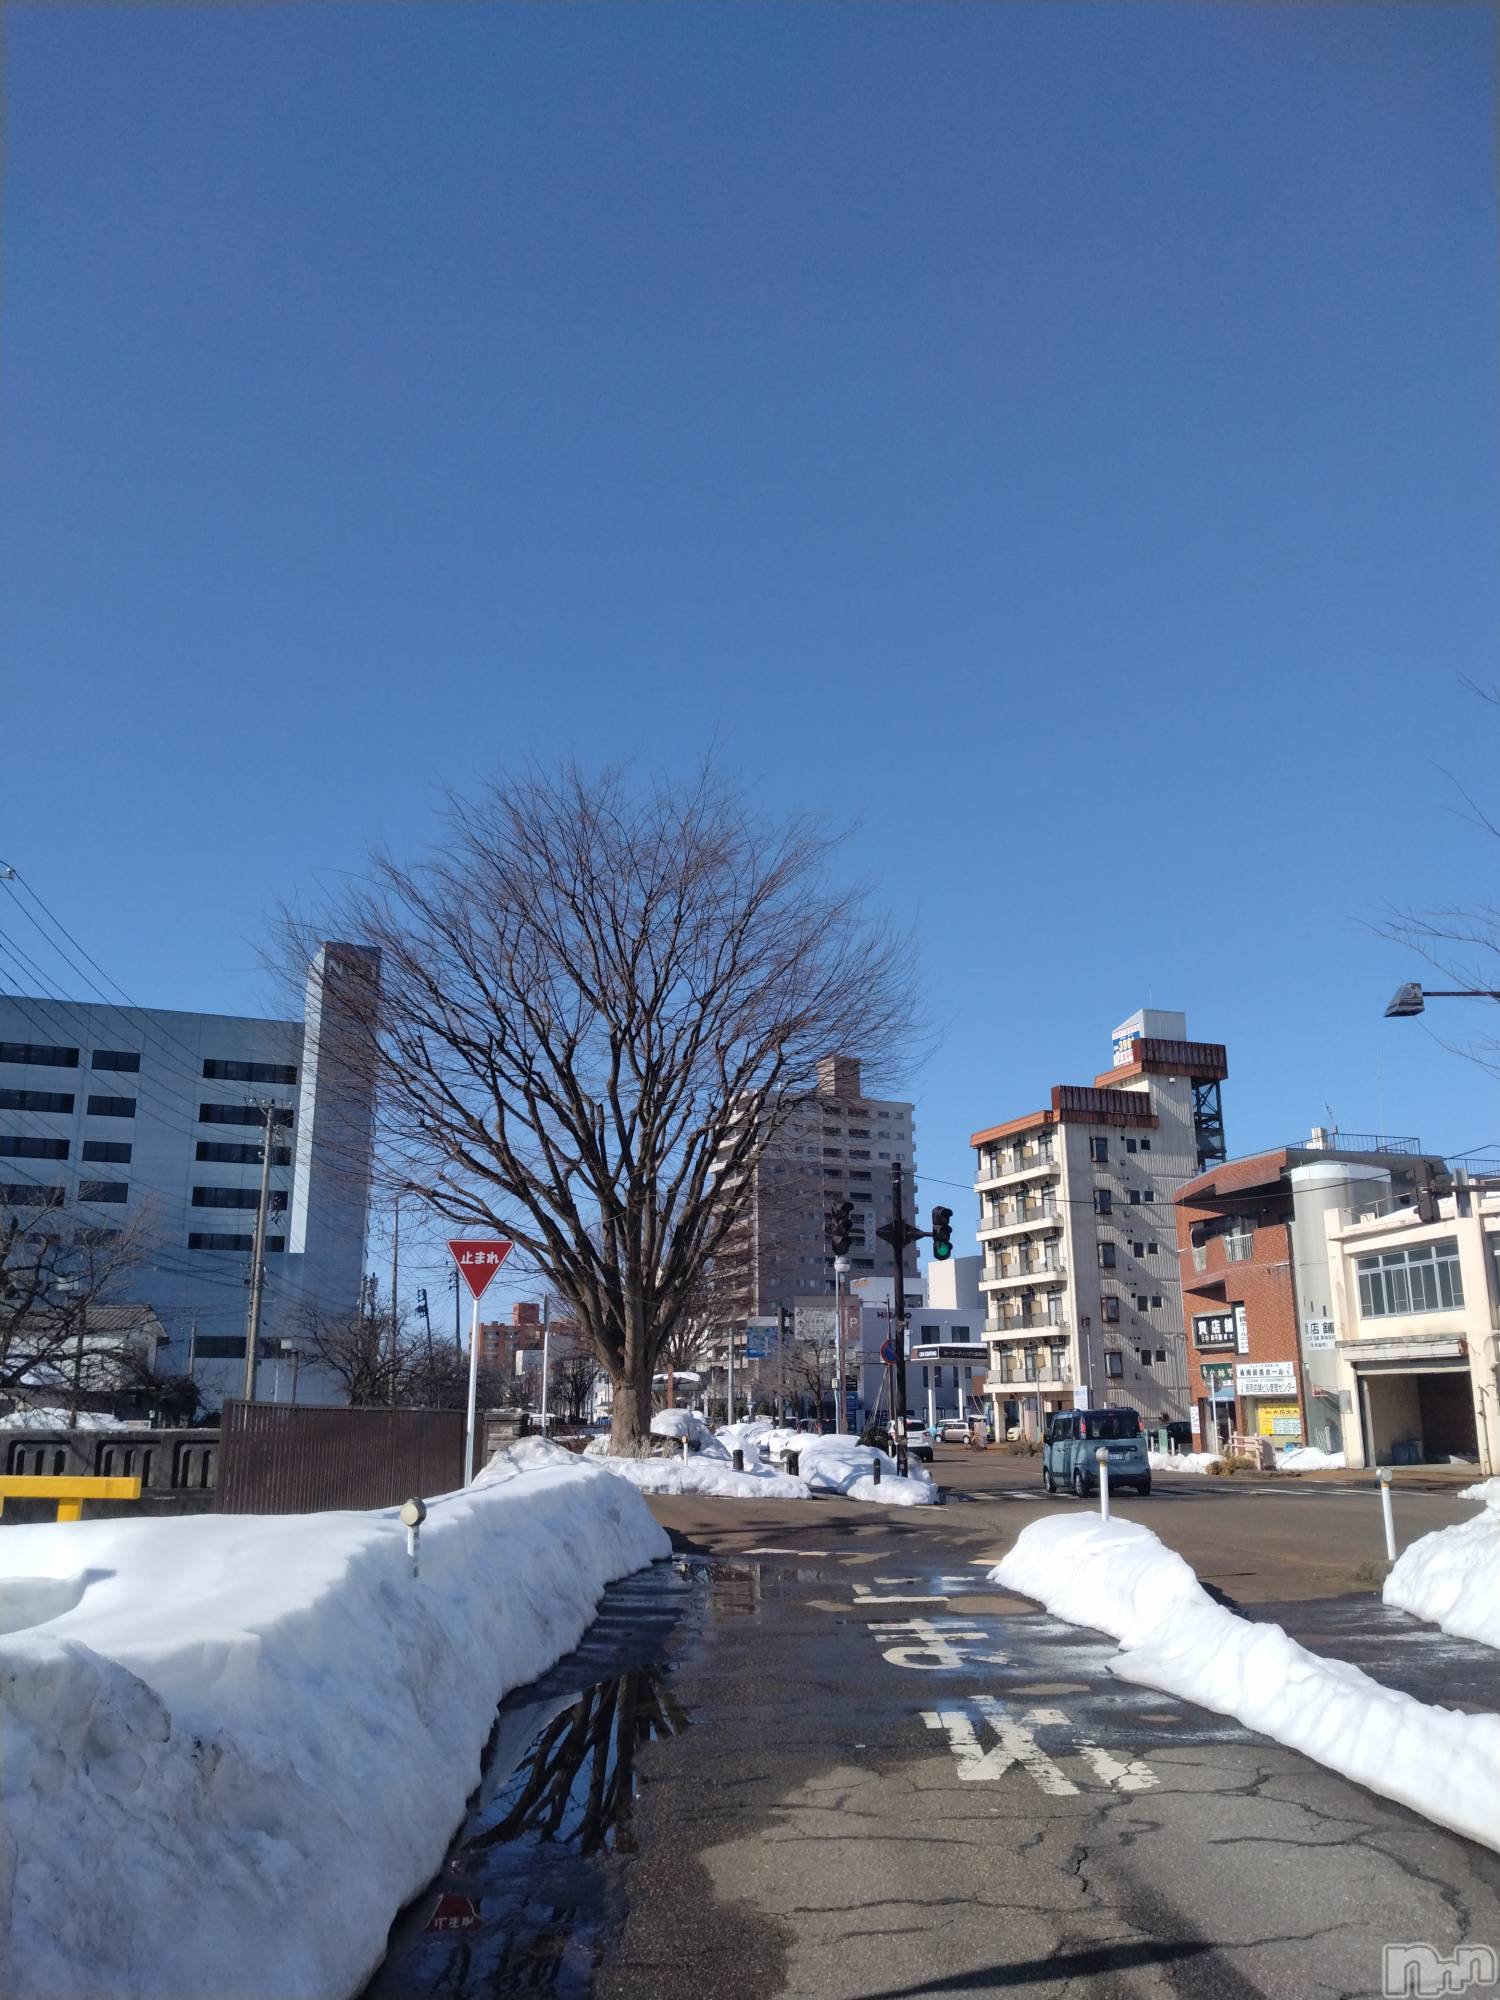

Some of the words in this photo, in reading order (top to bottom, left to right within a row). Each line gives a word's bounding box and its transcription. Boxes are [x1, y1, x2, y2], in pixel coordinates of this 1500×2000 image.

[460, 1250, 500, 1265] 止まれ
[853, 1575, 1160, 1796] 止まれ
